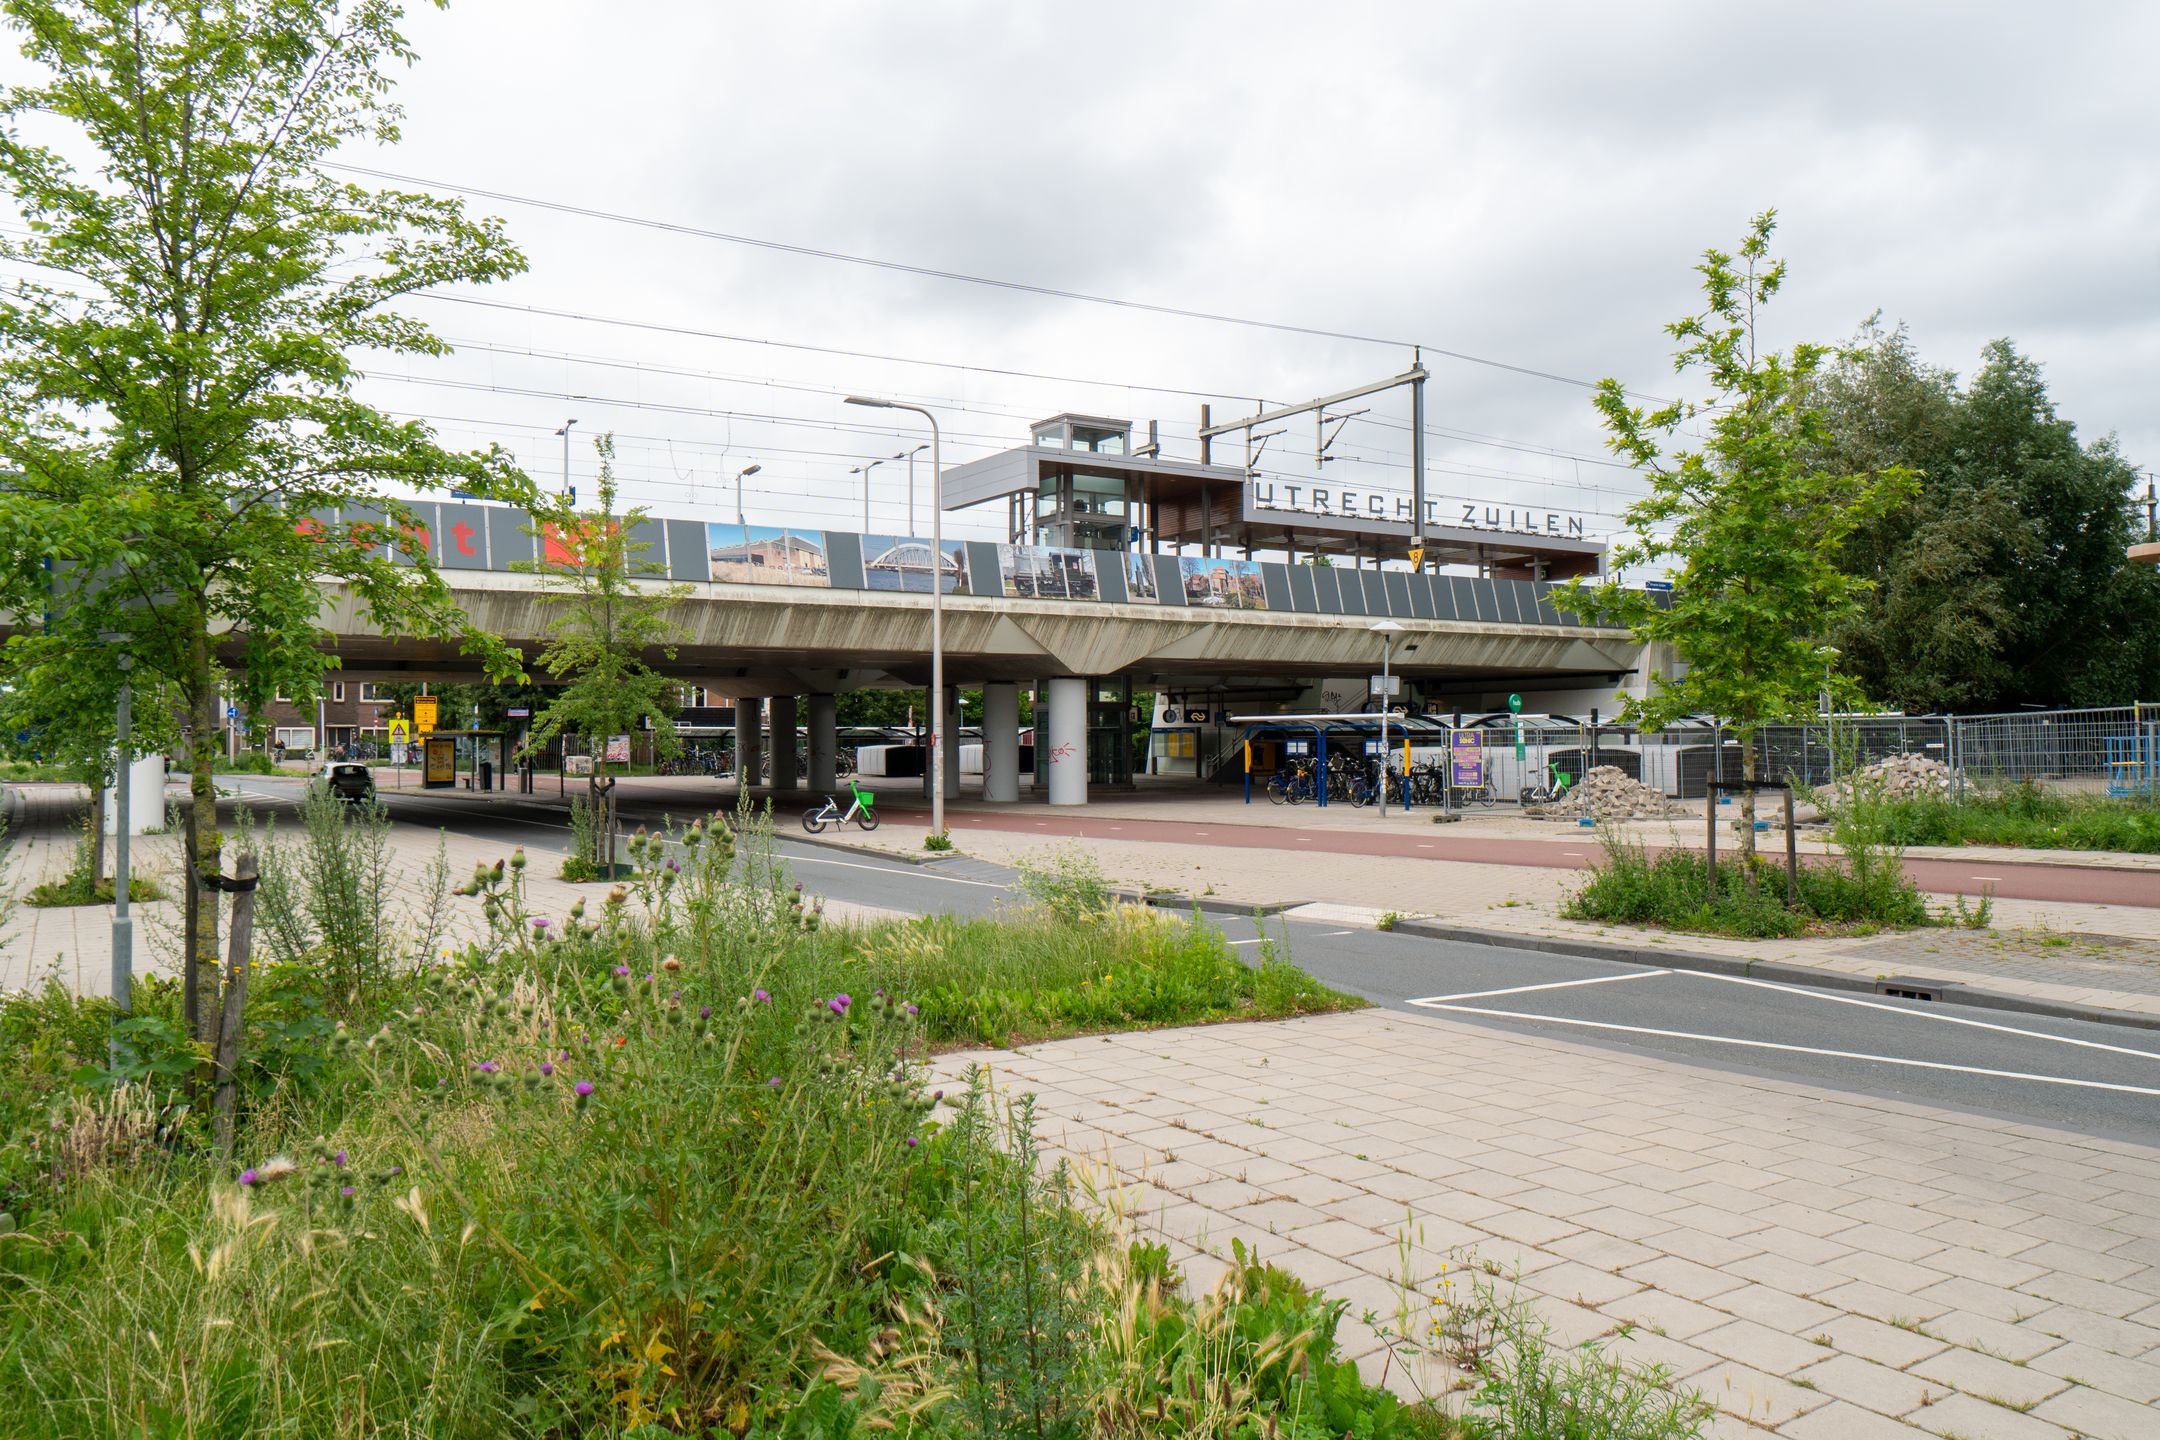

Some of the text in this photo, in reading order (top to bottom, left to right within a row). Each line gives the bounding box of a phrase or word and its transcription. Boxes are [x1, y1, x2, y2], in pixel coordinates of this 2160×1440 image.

[1255, 482, 1583, 534] UTRECHT ZUILEN
[1413, 551, 1419, 564] 8
